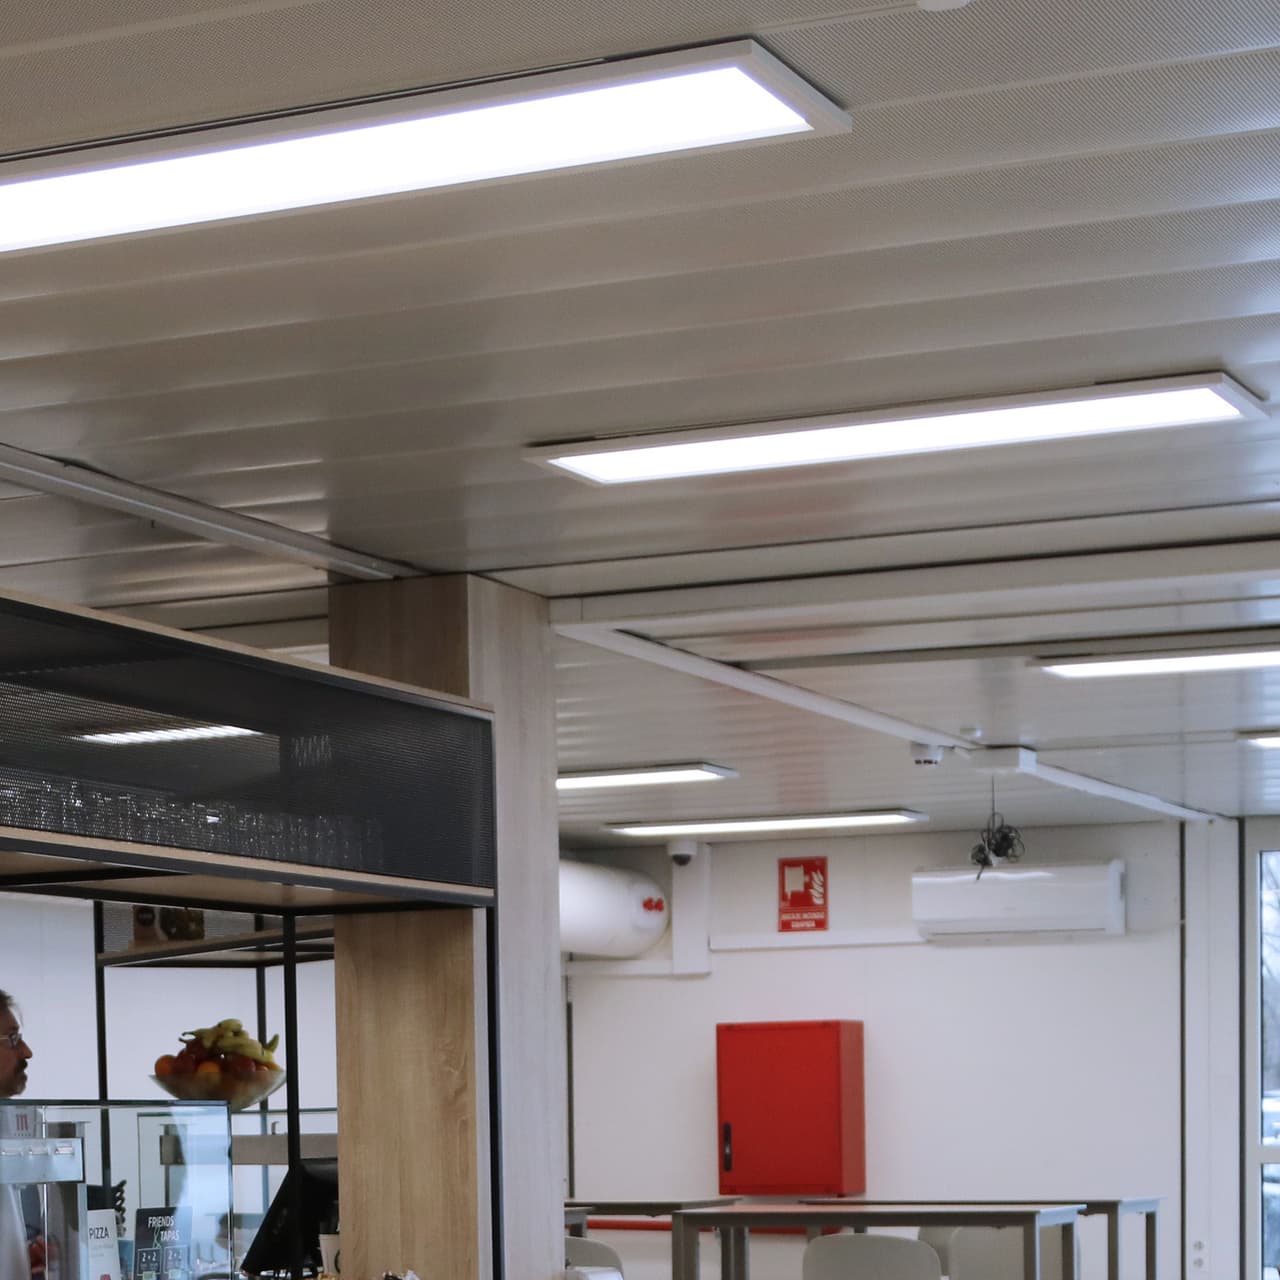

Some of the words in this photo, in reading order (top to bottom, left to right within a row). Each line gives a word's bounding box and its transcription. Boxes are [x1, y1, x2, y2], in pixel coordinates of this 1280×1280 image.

[148, 1216, 175, 1228] FRIENDS
[89, 1227, 109, 1240] PIZZA
[160, 1230, 180, 1241] TAPAS
